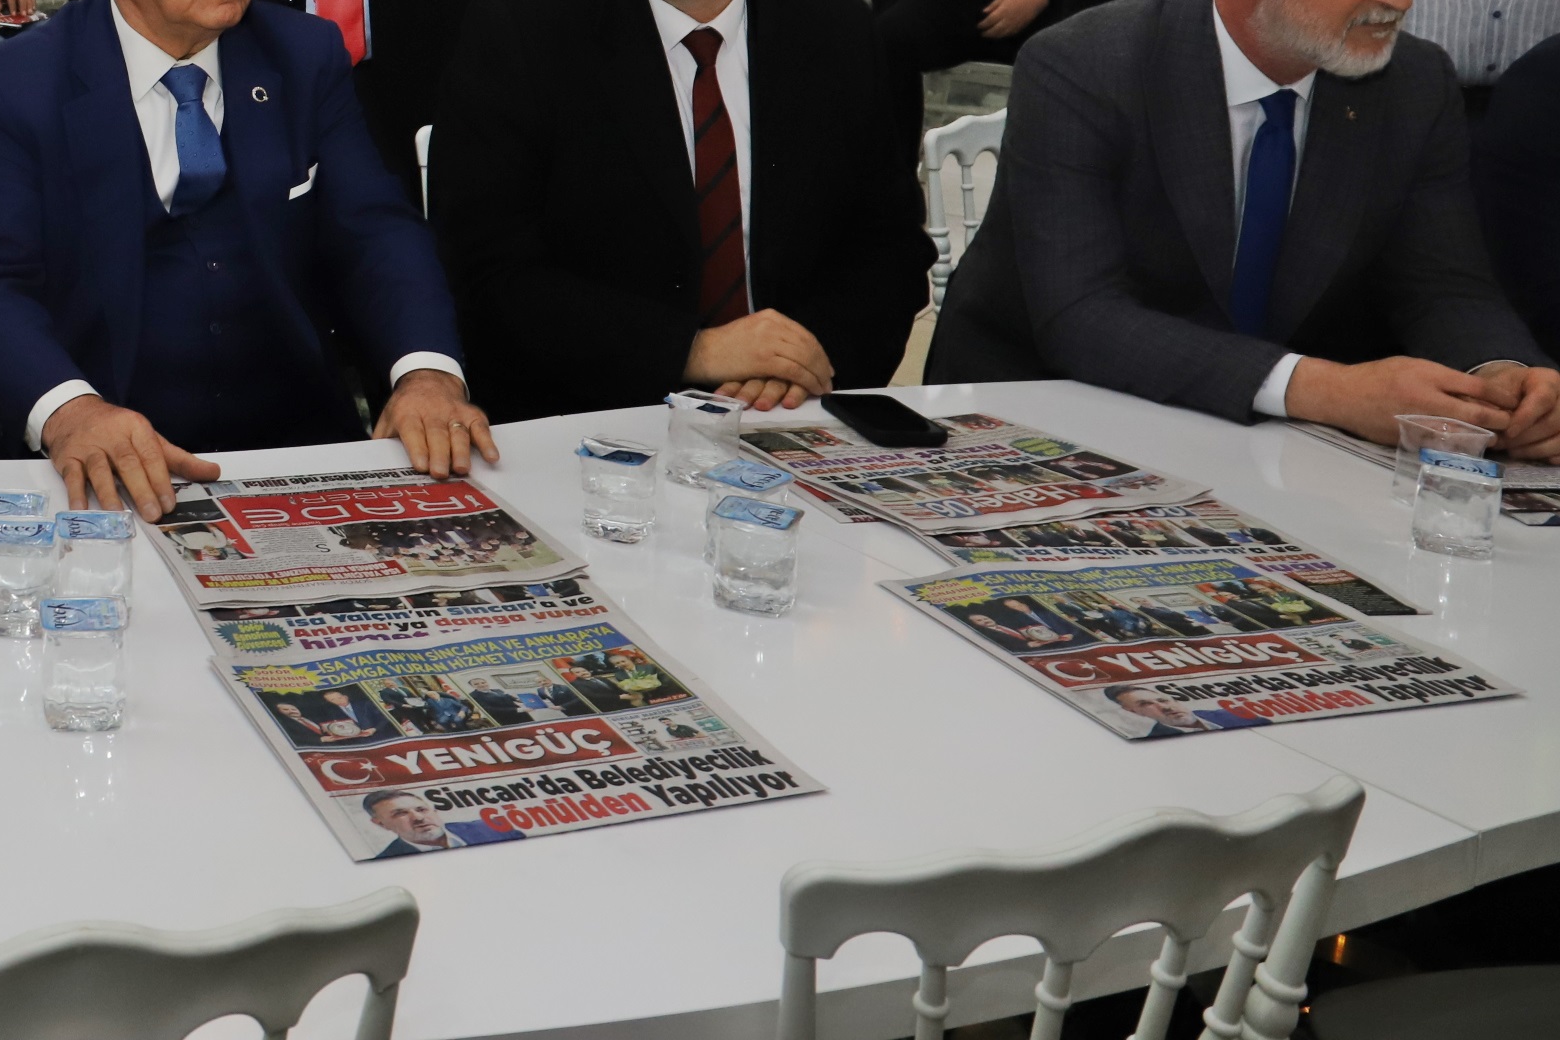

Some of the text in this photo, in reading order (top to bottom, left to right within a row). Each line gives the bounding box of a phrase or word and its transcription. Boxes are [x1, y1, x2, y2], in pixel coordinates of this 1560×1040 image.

[920, 485, 1083, 518] Haber 06
[434, 611, 527, 628] damga
[530, 605, 609, 621] vuran
[563, 596, 594, 607] ve
[317, 662, 347, 674] İSA
[426, 640, 500, 661] SİNCAN'A
[503, 638, 523, 649] VE
[525, 626, 615, 645] ANKARA'YA
[326, 637, 604, 685] DAMGA VURAN HİZMET YOLCULUĞU
[1102, 639, 1302, 674] YENİGÜÇ
[1290, 656, 1462, 688] Belediyecilik
[1217, 674, 1498, 720] Gönülden Yapılıyor
[386, 726, 613, 776] YENİGÜÇ
[424, 746, 774, 812] Sincan'da Belediyecilik
[479, 767, 801, 834] Gönülden Yapılıyor
